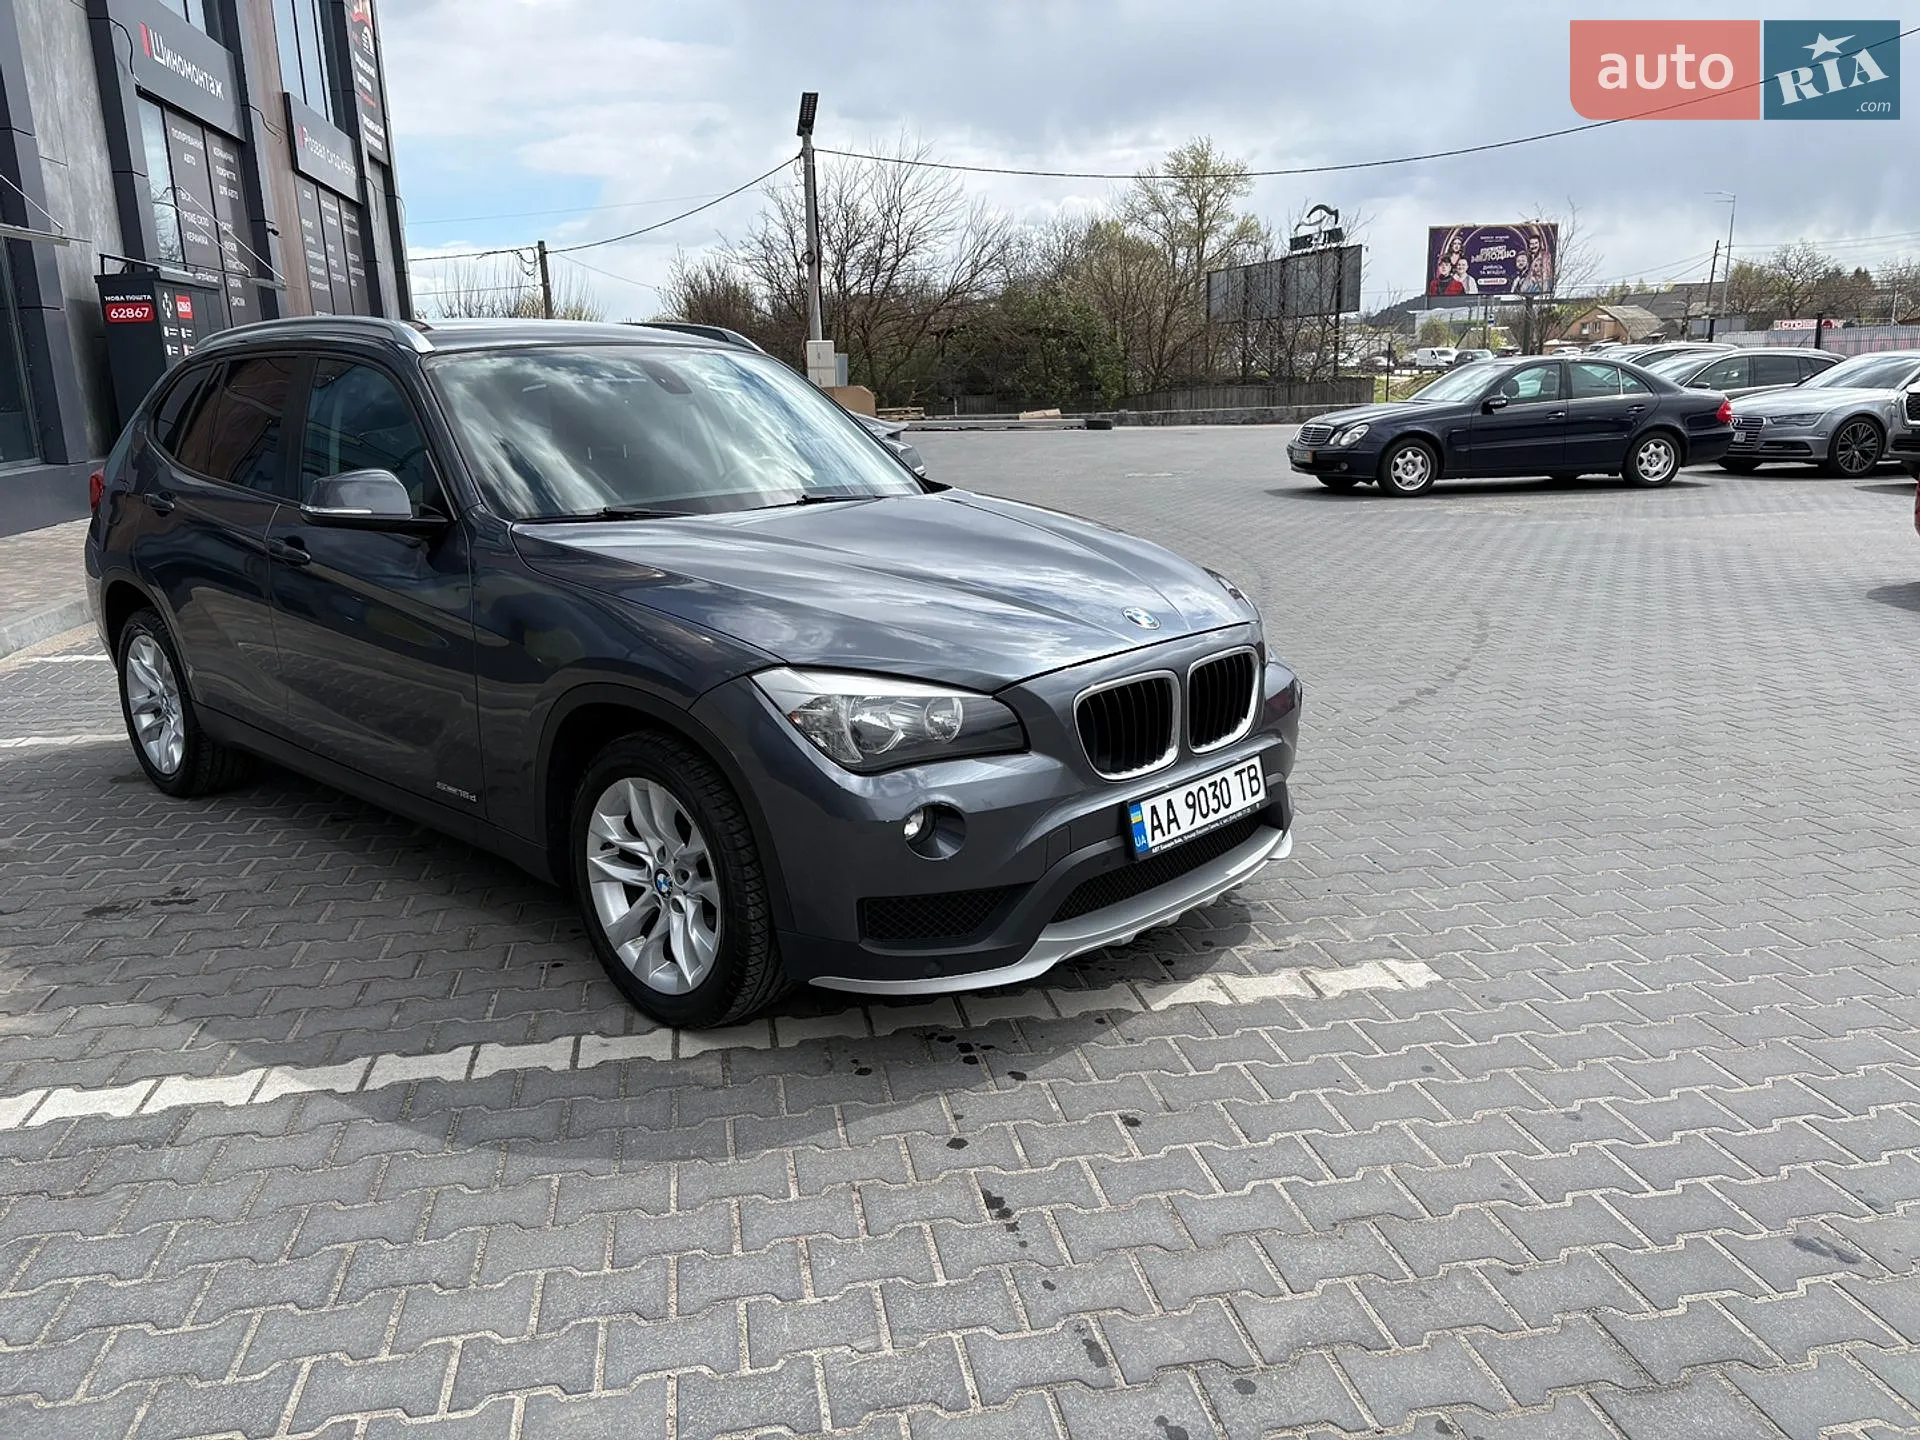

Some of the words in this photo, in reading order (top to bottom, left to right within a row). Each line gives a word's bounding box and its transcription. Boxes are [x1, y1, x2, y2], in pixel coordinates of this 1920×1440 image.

[110, 307, 150, 319] 62867
[1151, 798, 1182, 842] AA
[1185, 776, 1232, 827] 9030
[1234, 763, 1262, 802] TB
[1134, 834, 1148, 848] UA
